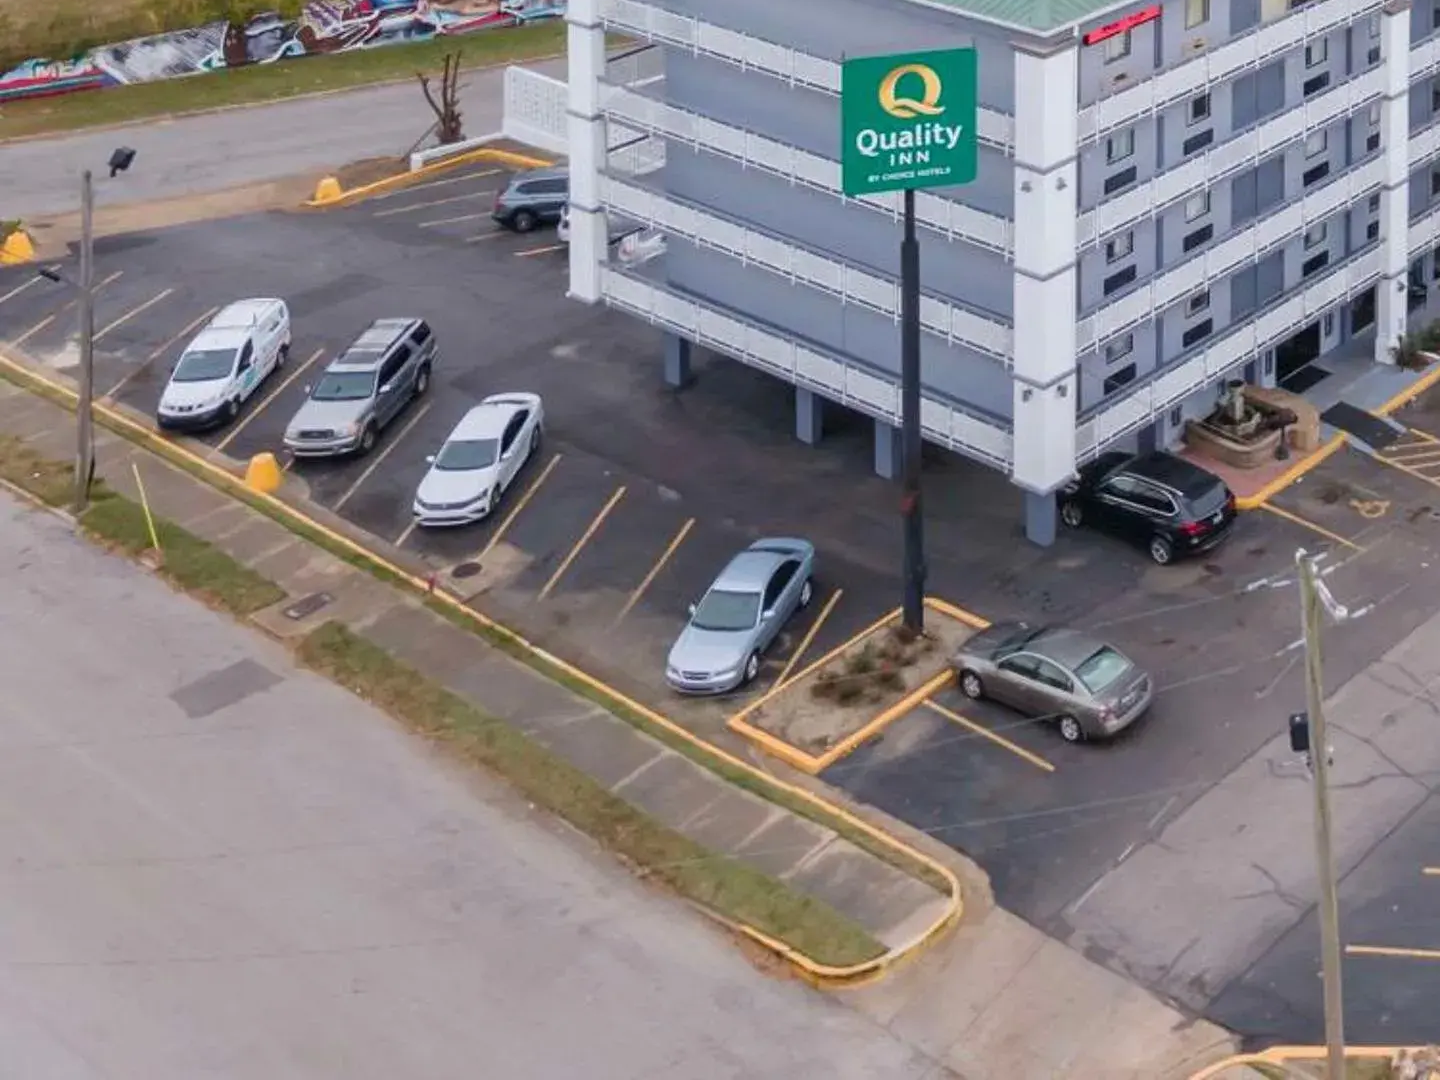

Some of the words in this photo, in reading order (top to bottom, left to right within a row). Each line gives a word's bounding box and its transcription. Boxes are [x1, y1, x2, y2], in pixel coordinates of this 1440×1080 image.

[878, 63, 946, 119] Q
[855, 122, 963, 157] Quality
[889, 150, 930, 166] INN
[867, 174, 880, 183] BY
